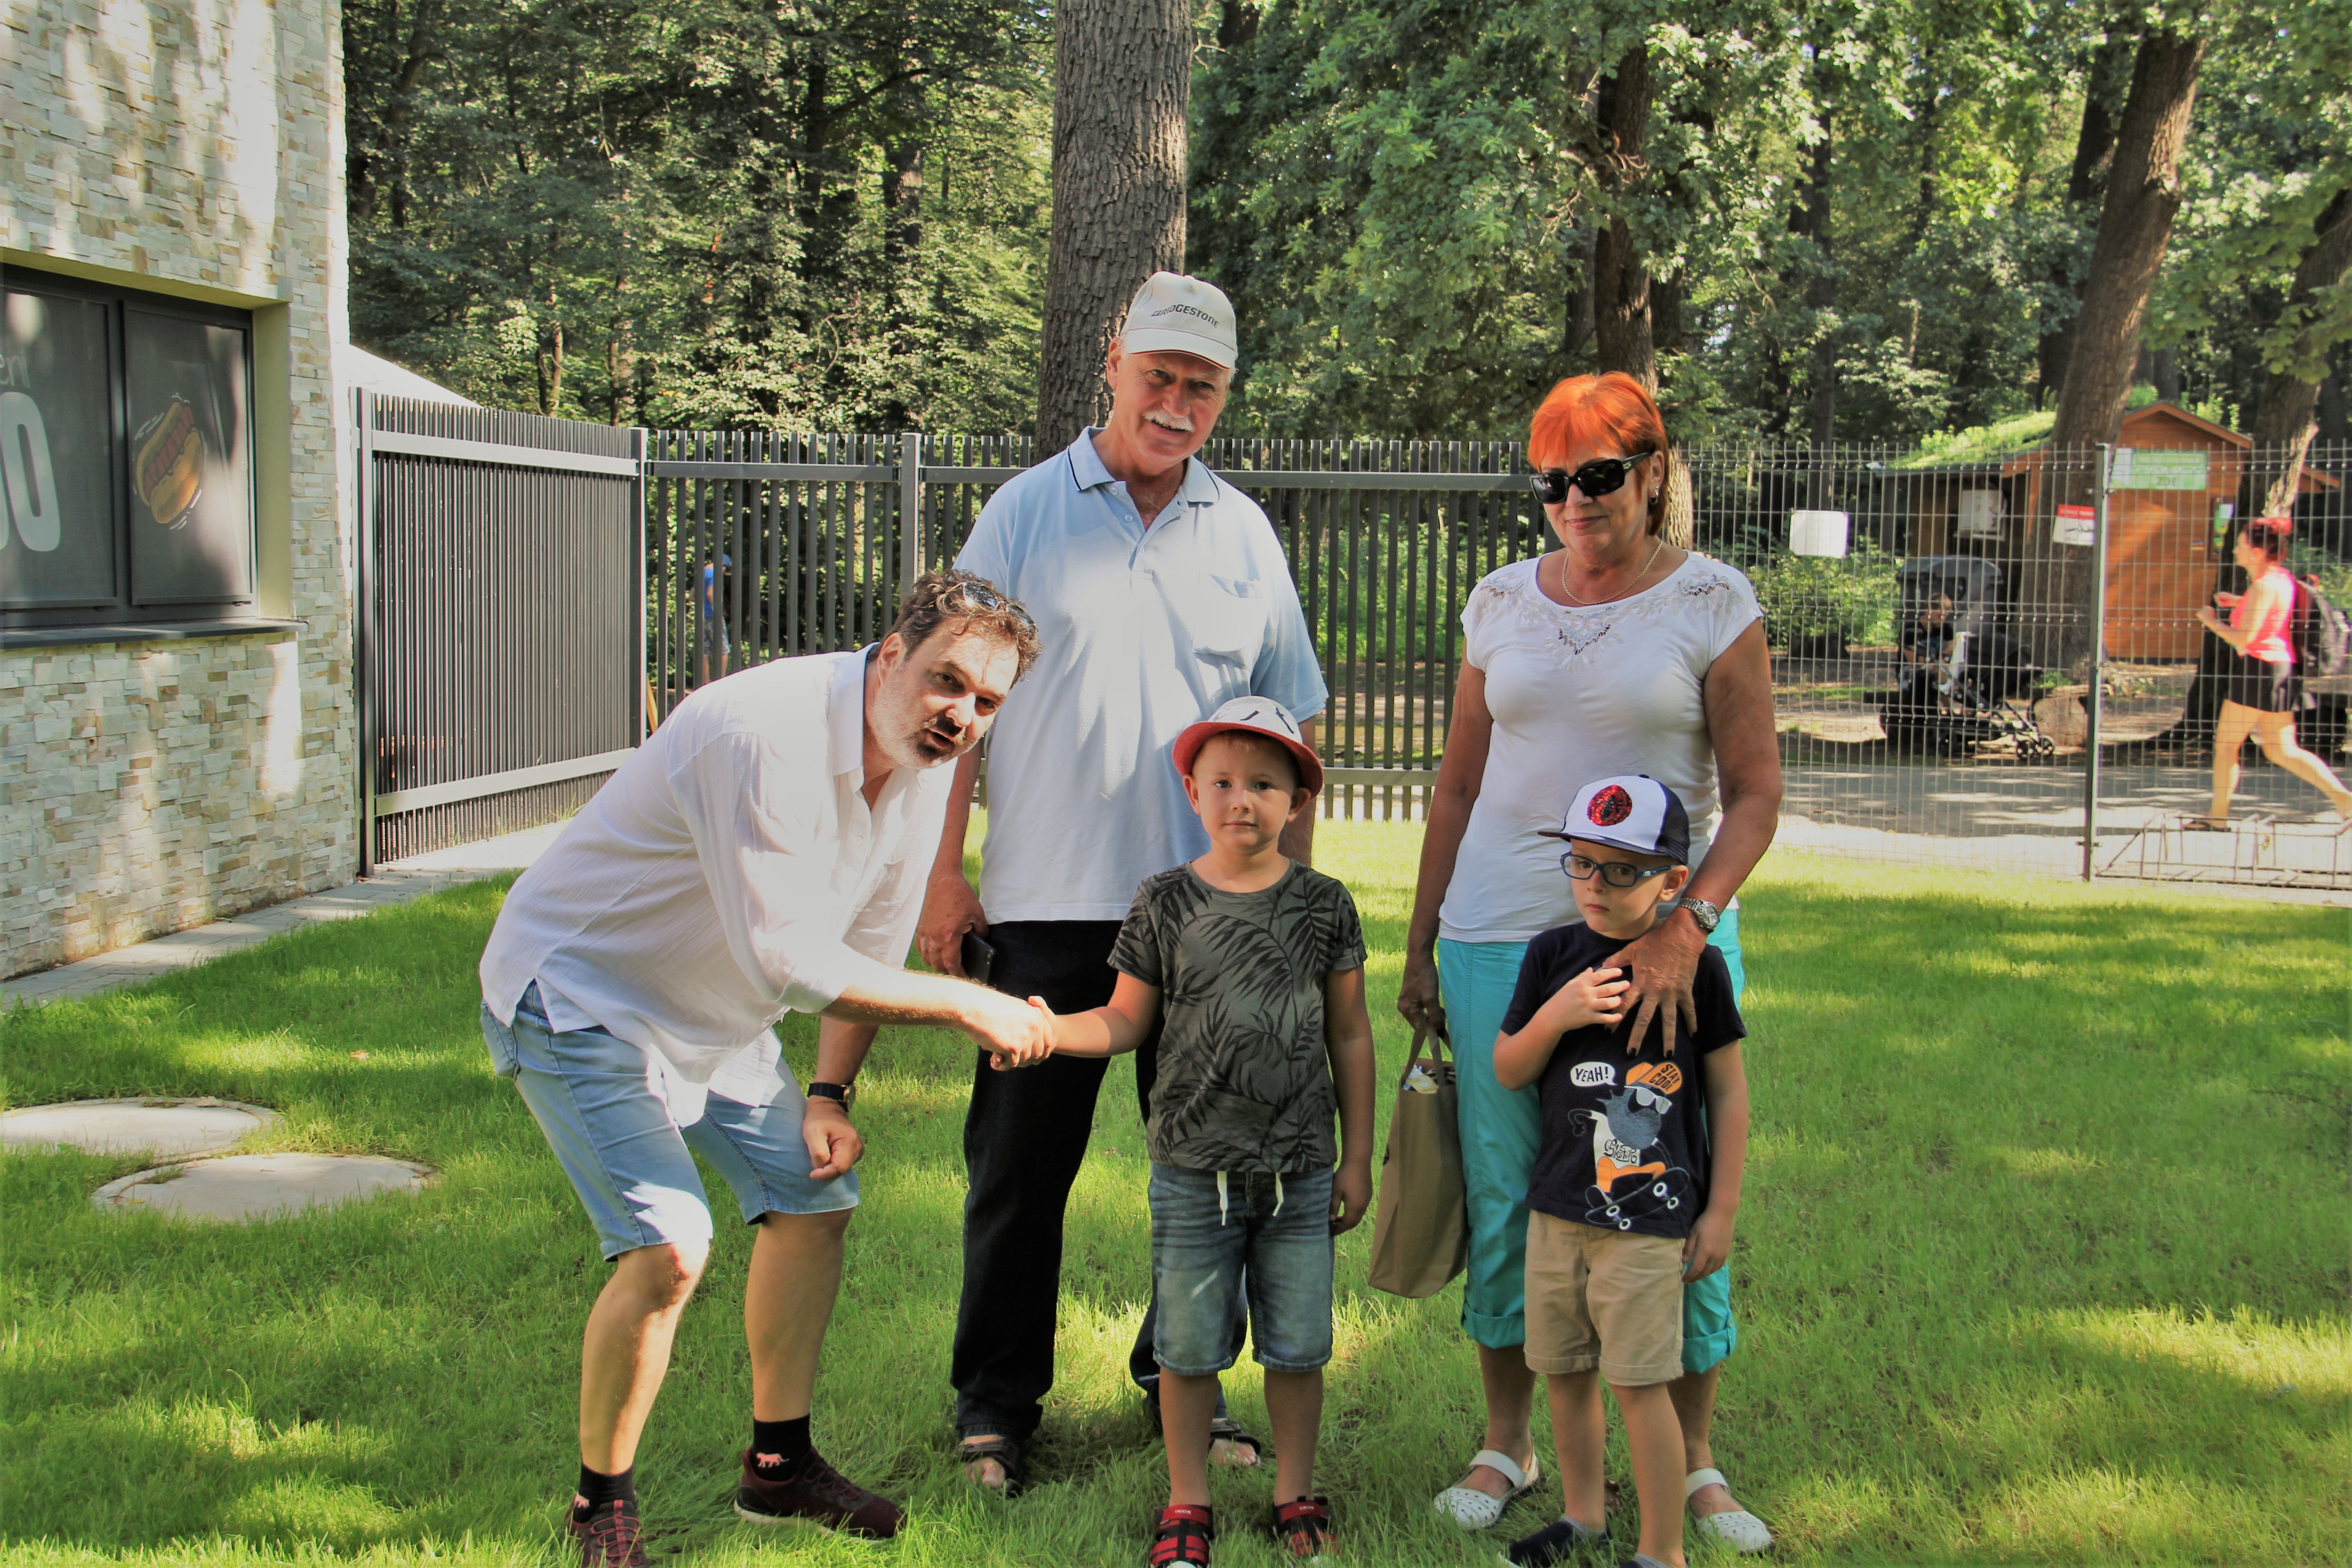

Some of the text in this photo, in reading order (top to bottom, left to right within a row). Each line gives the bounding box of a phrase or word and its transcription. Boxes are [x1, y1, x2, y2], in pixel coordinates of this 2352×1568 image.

[1150, 304, 1219, 328] BRIDGESTONE
[2156, 476, 2177, 486] ZDE
[1575, 1066, 1608, 1082] YEAH!
[1649, 1072, 1672, 1091] COOL
[1661, 1063, 1681, 1084] STAY
